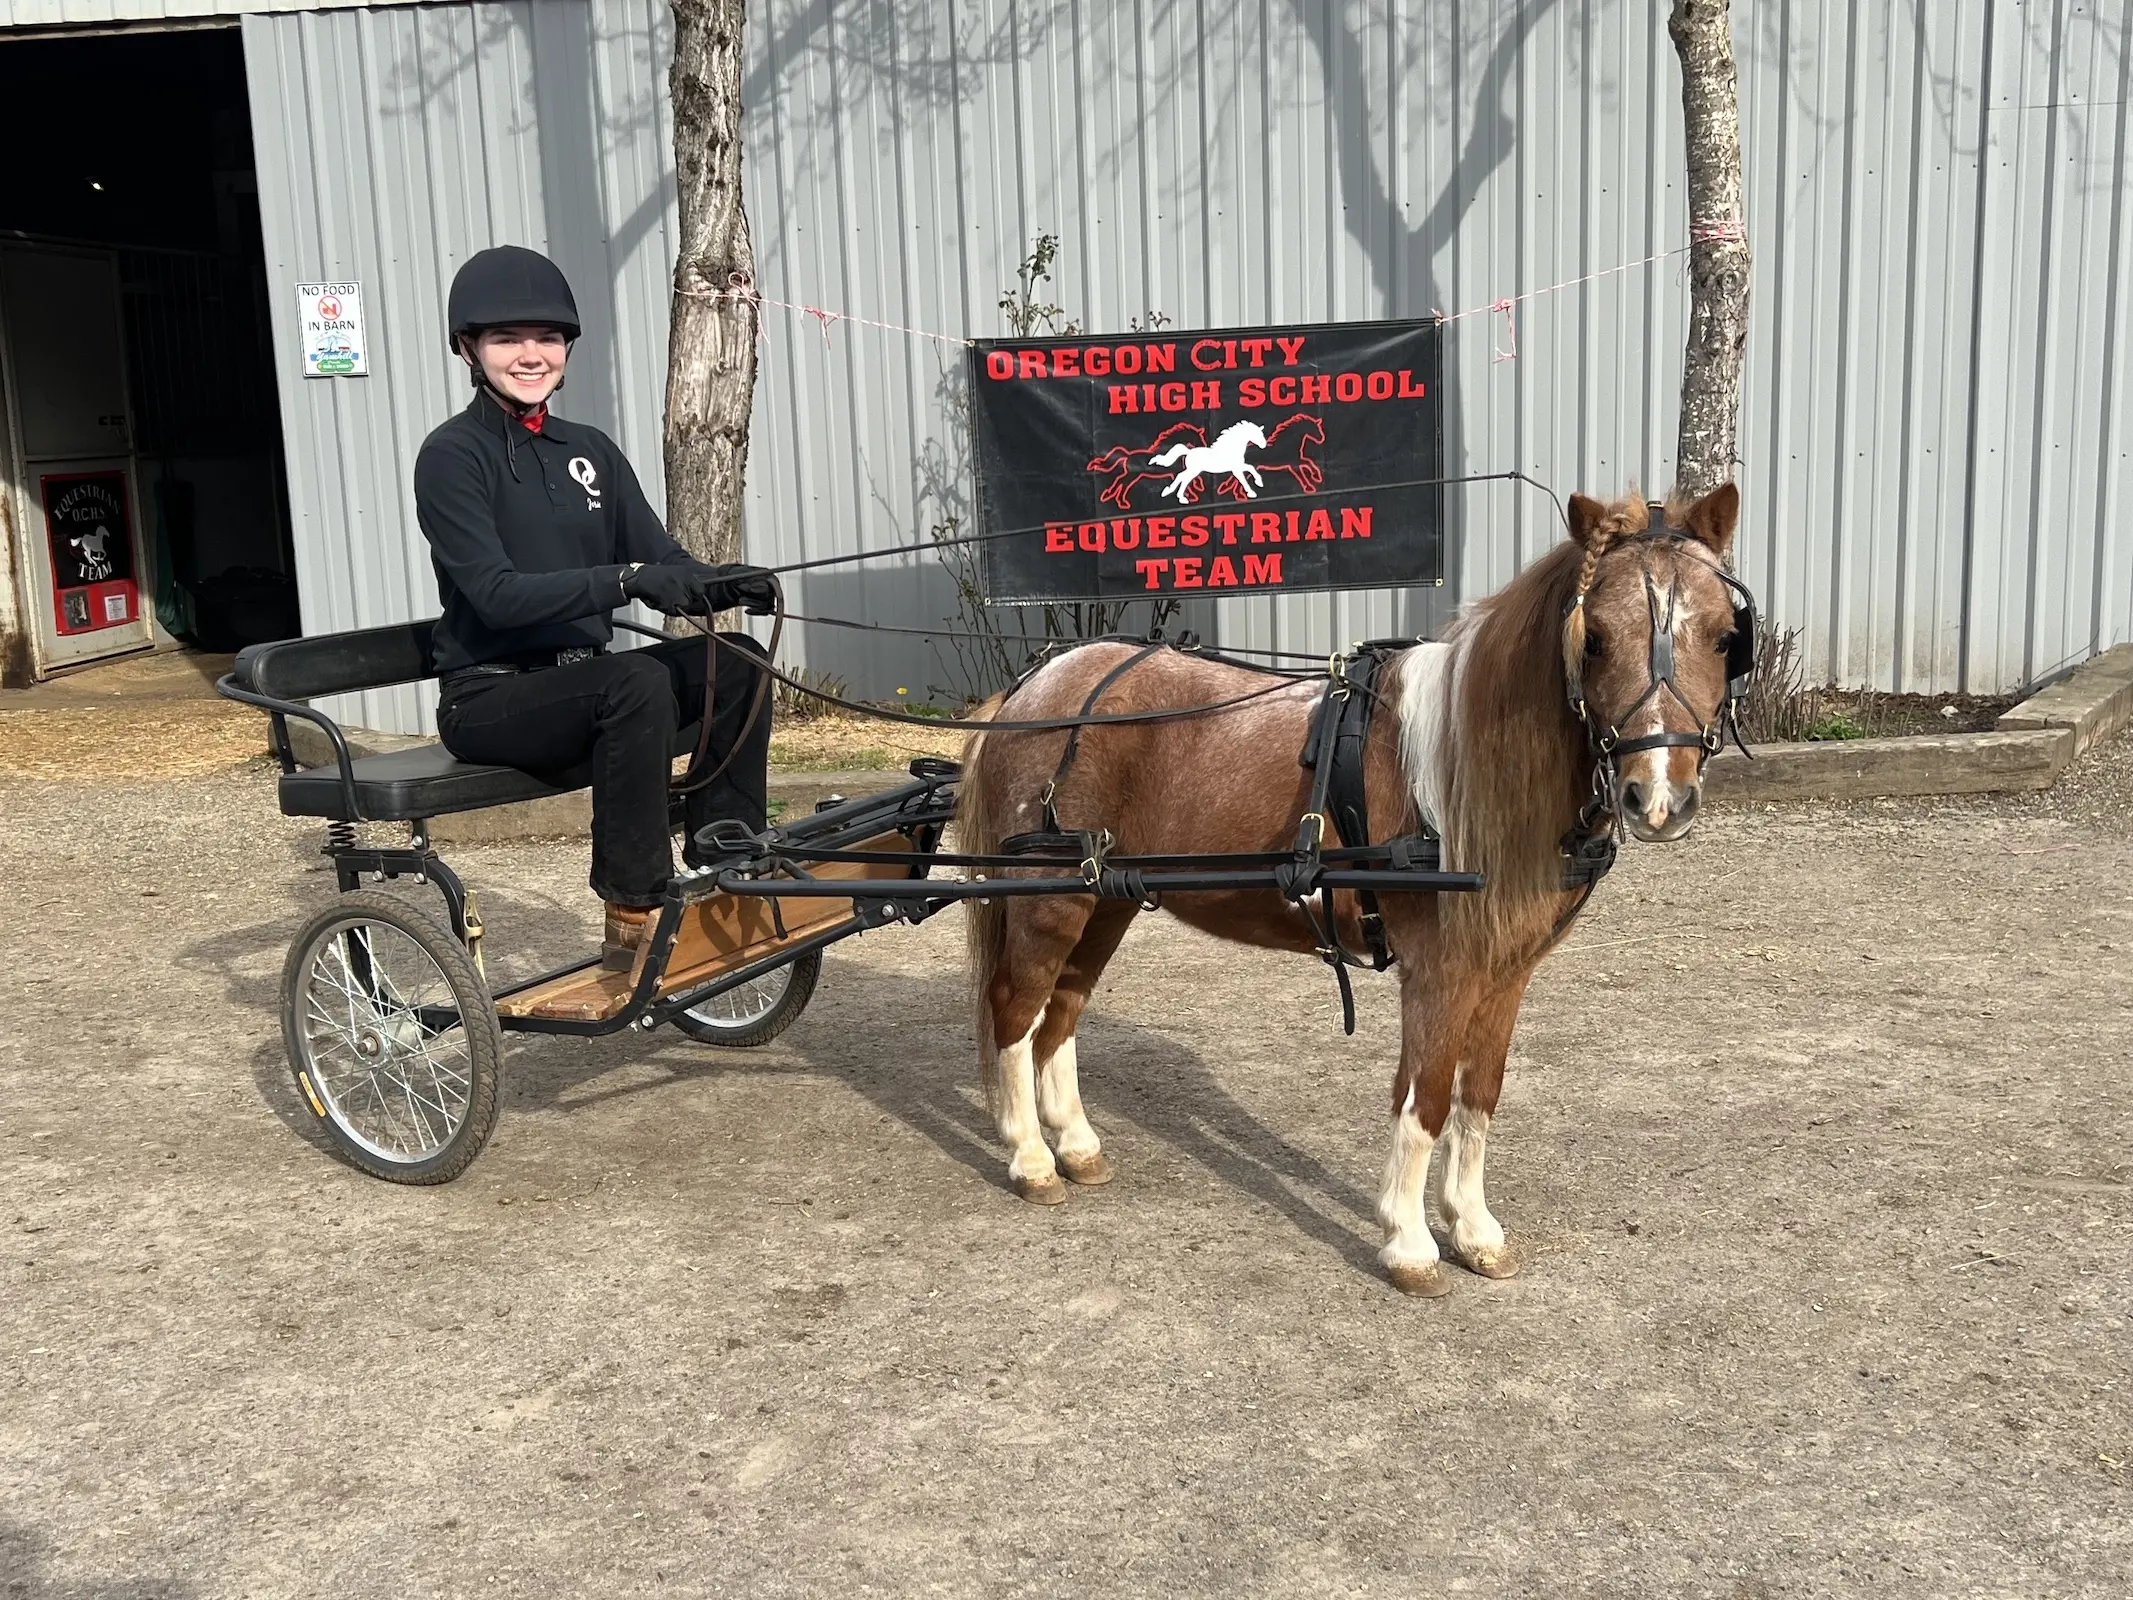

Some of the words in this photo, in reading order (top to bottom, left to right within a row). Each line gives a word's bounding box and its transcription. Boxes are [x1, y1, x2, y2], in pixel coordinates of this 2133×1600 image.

[302, 286, 319, 296] NO
[323, 285, 355, 296] FOOD
[308, 321, 320, 331] IN
[323, 320, 355, 331] BARN
[986, 343, 1176, 381] OREGON
[1190, 336, 1305, 371] CITY
[1107, 380, 1222, 414] HIGH
[1239, 369, 1425, 408] SCHOOL
[53, 483, 121, 521] EQUESTRIAN
[1044, 506, 1373, 553] EQUESTRIAN
[79, 561, 113, 581] TEAM
[1135, 553, 1283, 590] TEAM
